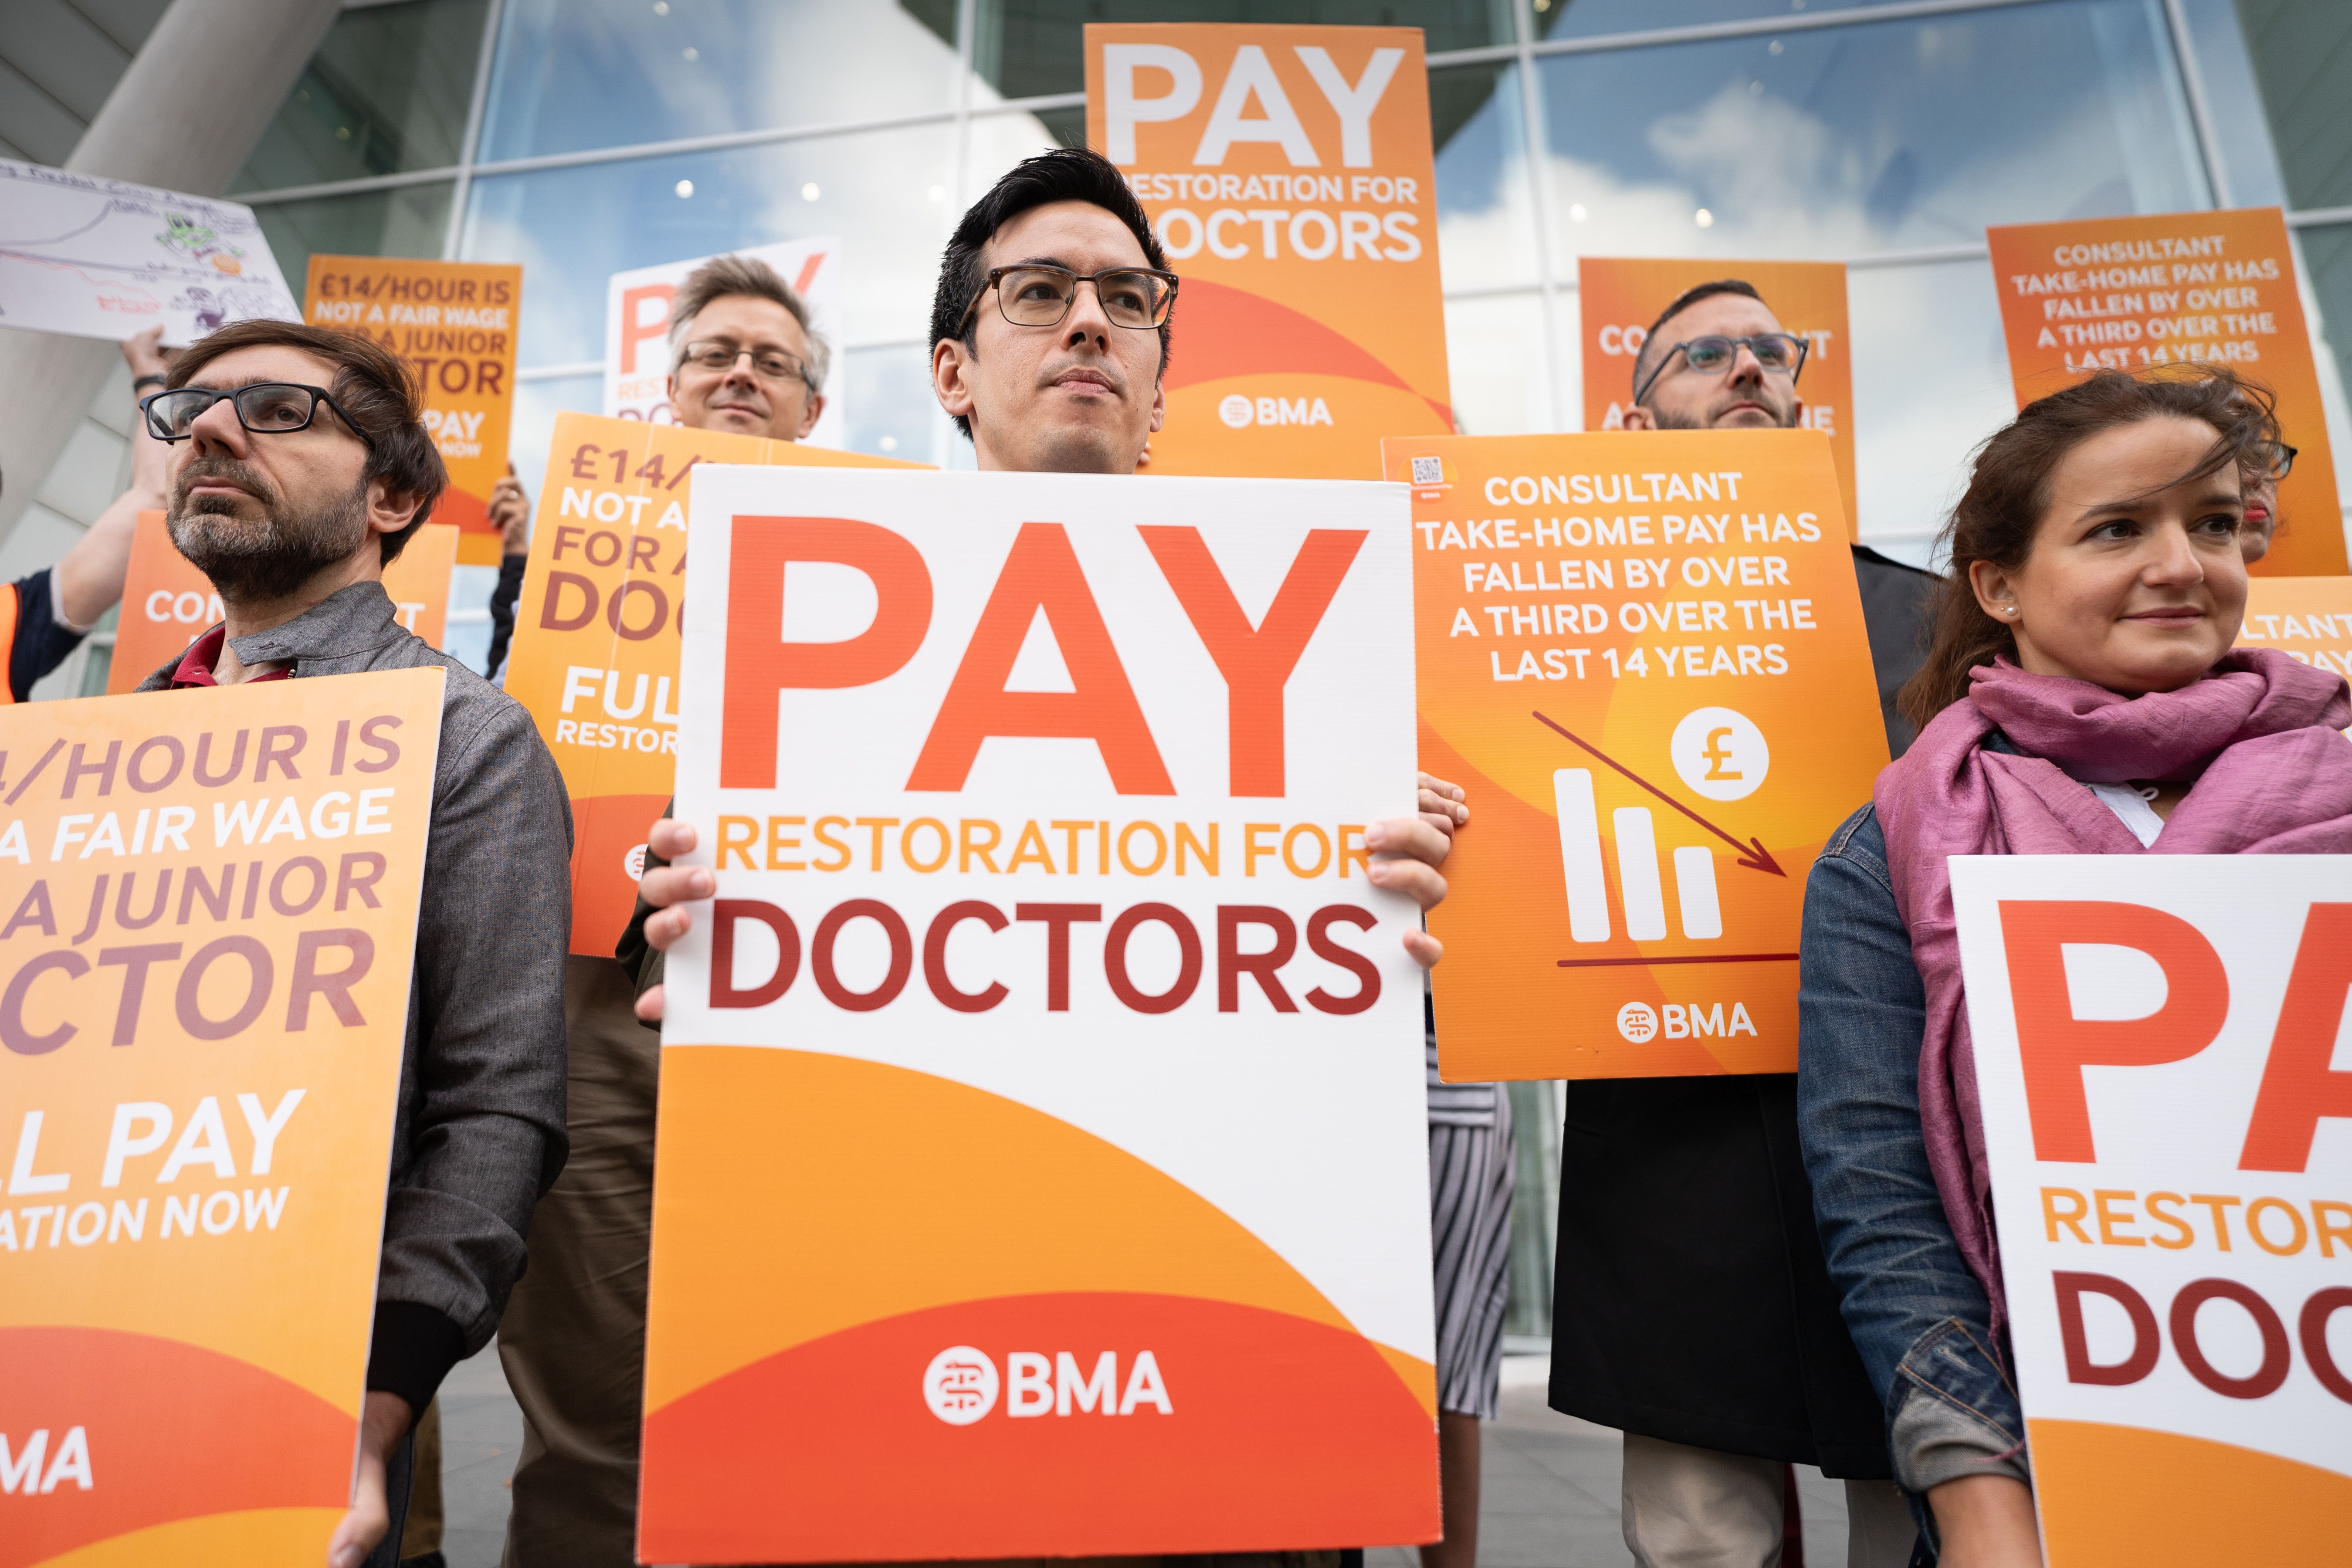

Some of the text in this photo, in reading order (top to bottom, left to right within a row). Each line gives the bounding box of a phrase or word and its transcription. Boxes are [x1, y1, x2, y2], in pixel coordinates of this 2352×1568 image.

[1103, 44, 1406, 168] PAY
[1124, 173, 1419, 205] ESTORATION FOR
[1150, 207, 1422, 261] OCTORS
[2053, 235, 2225, 267] CONSULTANT
[319, 273, 510, 305] £14/HOUR IS
[2011, 258, 2280, 296] TAKE-HOME PAY HAS
[315, 300, 510, 330] NOT A FAIR WAGE
[2043, 287, 2259, 321] FALLEN BY OVER
[403, 329, 508, 355] JUNIOR
[2036, 312, 2277, 349] A THIRD OVER THE
[2064, 340, 2260, 373] LAST 14 YEARS
[1256, 396, 1333, 426] BMA
[559, 486, 687, 532] NOT A
[1484, 471, 1742, 506] CONSULTANT
[552, 525, 661, 573] FOR
[1416, 512, 1822, 551] TAKE-HOME PAY HAS
[1463, 555, 1791, 593] FALLEN BY OVER
[539, 570, 684, 641] DO
[1449, 599, 1817, 638] A THIRD OVER THE
[720, 515, 1370, 798] PAY
[1491, 643, 1789, 682] LAST 14 YEARS
[329, 715, 404, 777] IS
[0, 787, 396, 865] A FAIR WAGE
[715, 814, 1373, 879] RESTORATION FOR
[0, 850, 387, 946] A JUNIOR
[709, 897, 1383, 1016] DOCTORS
[0, 927, 376, 1057] CTOR
[1662, 1002, 1758, 1039] BMA
[0, 1088, 308, 1196] L PAY
[159, 1185, 291, 1240] NOW
[2039, 1185, 2352, 1260] RESTOR
[1007, 1350, 1175, 1418] BMA
